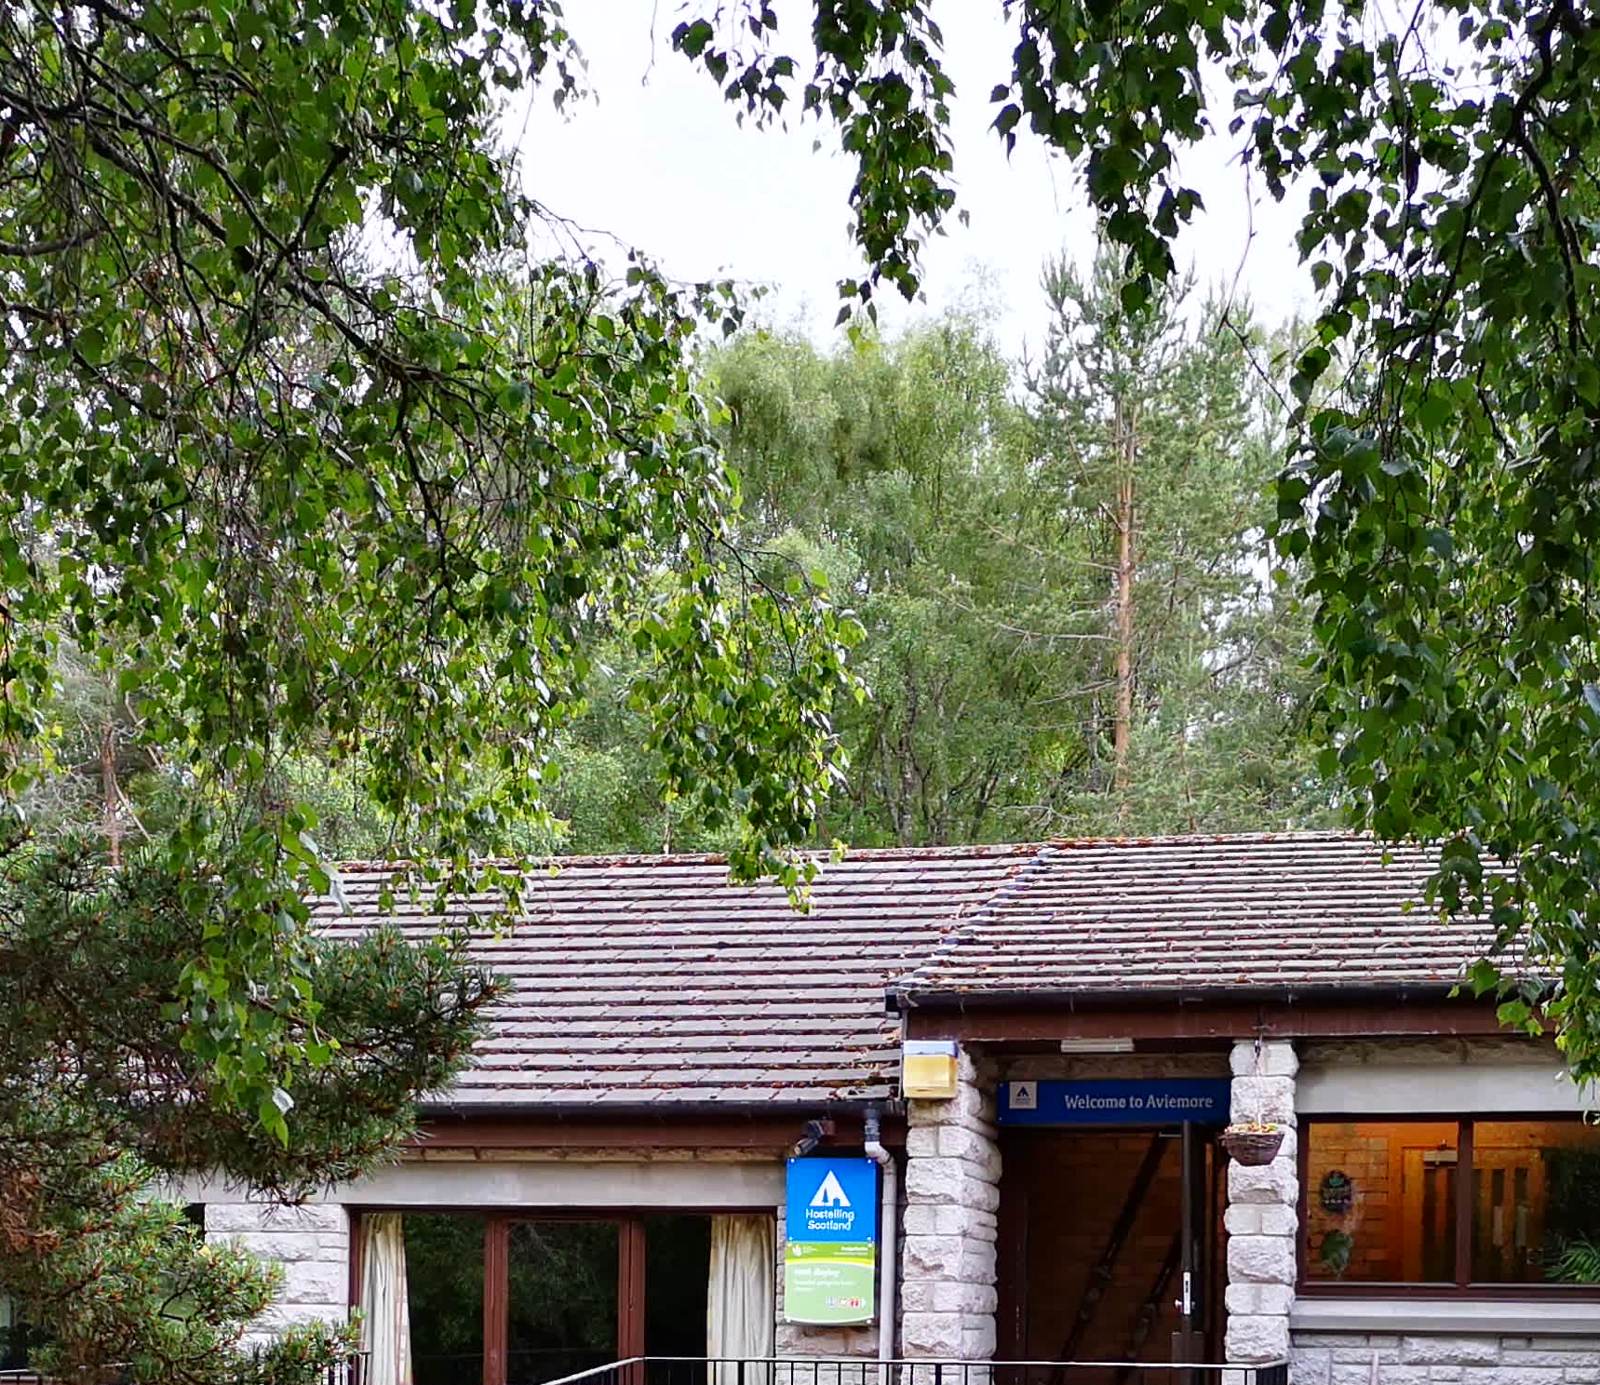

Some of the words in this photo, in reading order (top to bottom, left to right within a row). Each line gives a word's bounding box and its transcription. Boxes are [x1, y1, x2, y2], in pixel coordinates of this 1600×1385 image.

[1064, 1094, 1127, 1110] Welcome
[1129, 1095, 1144, 1109] to
[1146, 1093, 1214, 1109] Aviemore
[805, 1209, 854, 1222] Hostelling
[807, 1220, 850, 1230] Scotland
